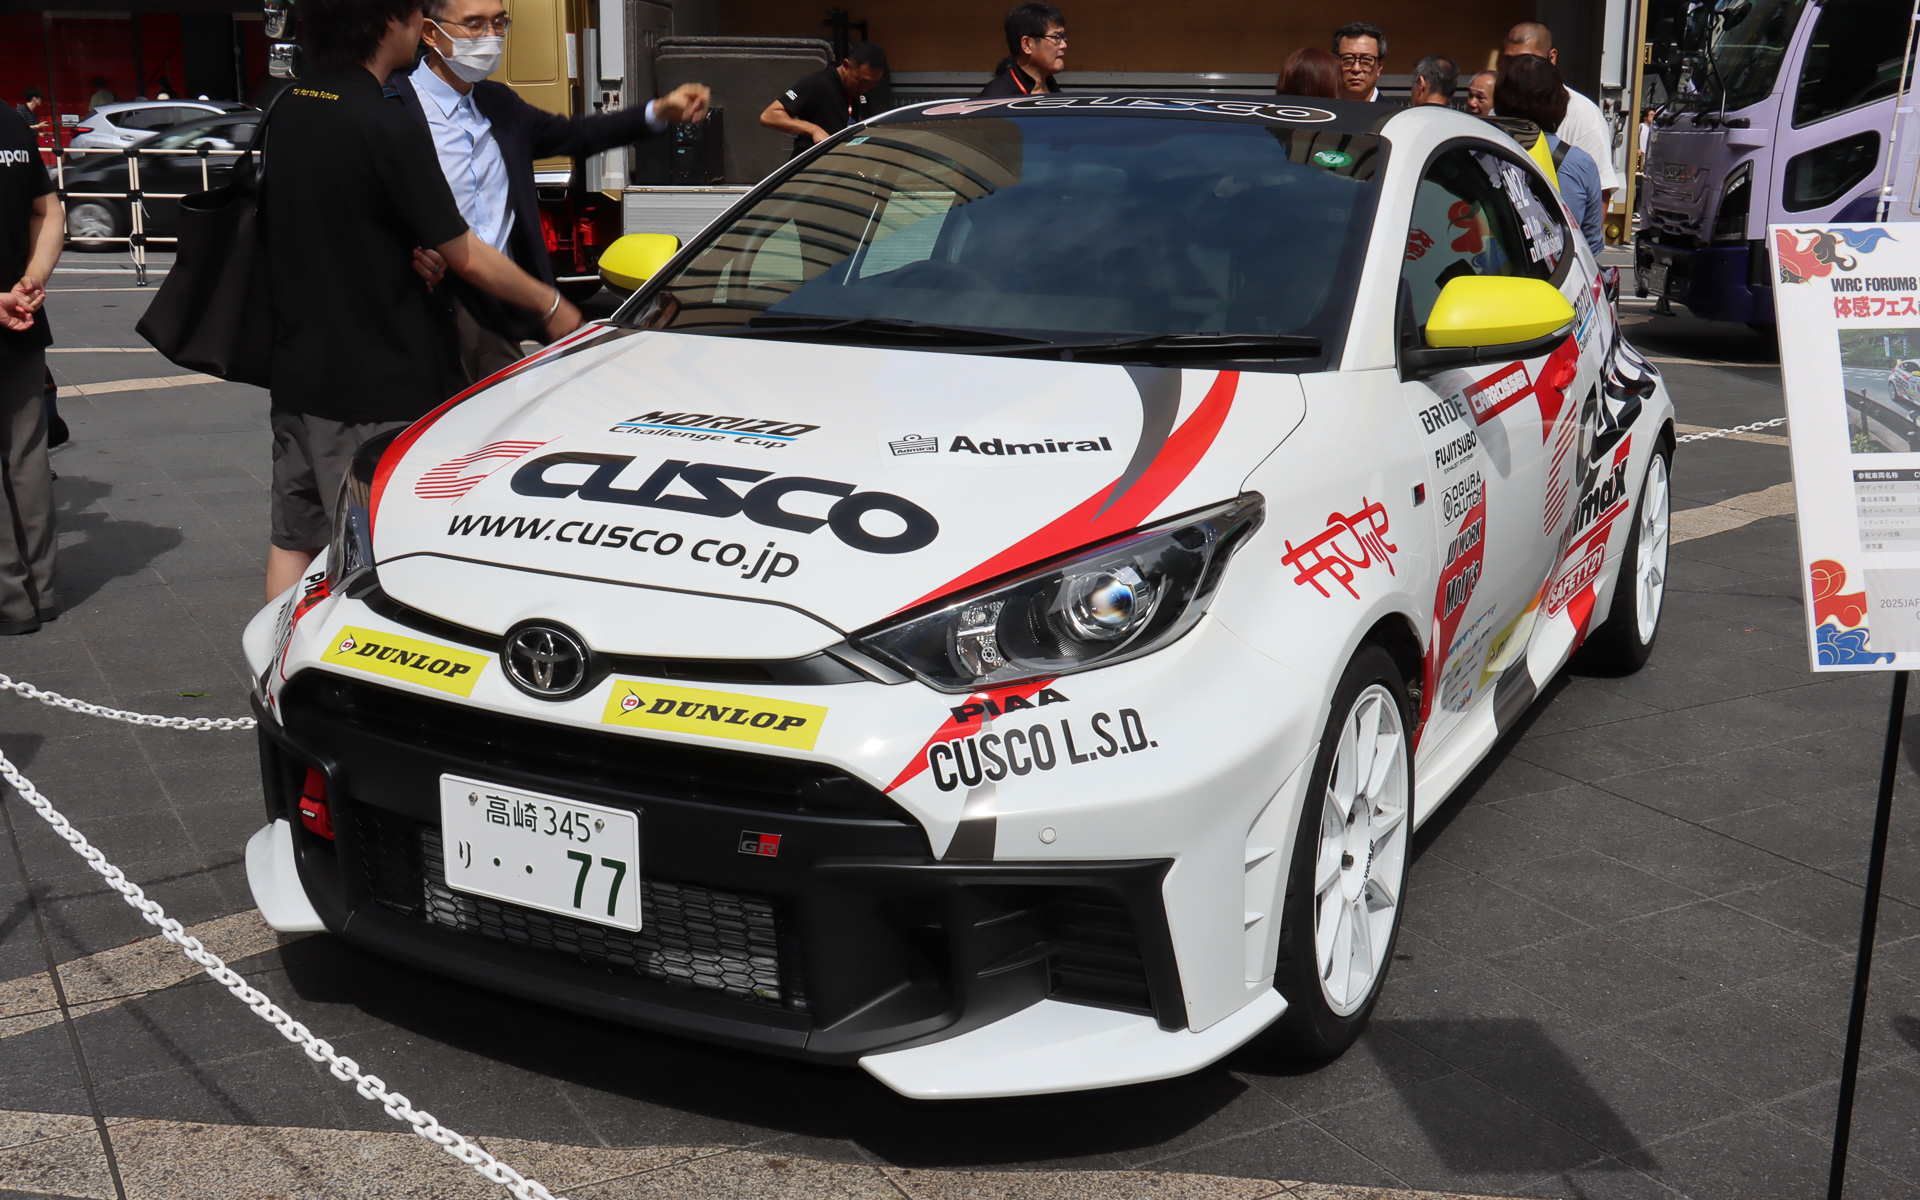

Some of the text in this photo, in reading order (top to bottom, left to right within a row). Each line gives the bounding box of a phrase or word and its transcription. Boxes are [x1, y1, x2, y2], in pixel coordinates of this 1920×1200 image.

[1831, 277, 1918, 292] WRC FORUM8
[1471, 369, 1529, 414] CARROSSER
[625, 411, 821, 436] MORIZO
[1419, 394, 1467, 435] BRIDE
[609, 426, 788, 449] Challenge Cup
[896, 436, 1112, 455] Admiral Admiral
[1435, 430, 1477, 469] FUJITSUBO
[510, 451, 939, 554] CUSCO
[1452, 470, 1481, 501] OGURA
[1453, 485, 1482, 518] CLUTCH
[1880, 599, 1920, 608] 2025JAF
[355, 642, 471, 678] DUNLOP
[646, 698, 807, 731] DUNLOP
[950, 688, 1070, 723] PIAA
[929, 708, 1158, 792] CUSCO L.S.D.
[486, 795, 590, 842] 高崎 345
[741, 840, 776, 855] GR
[567, 849, 626, 917] 77
